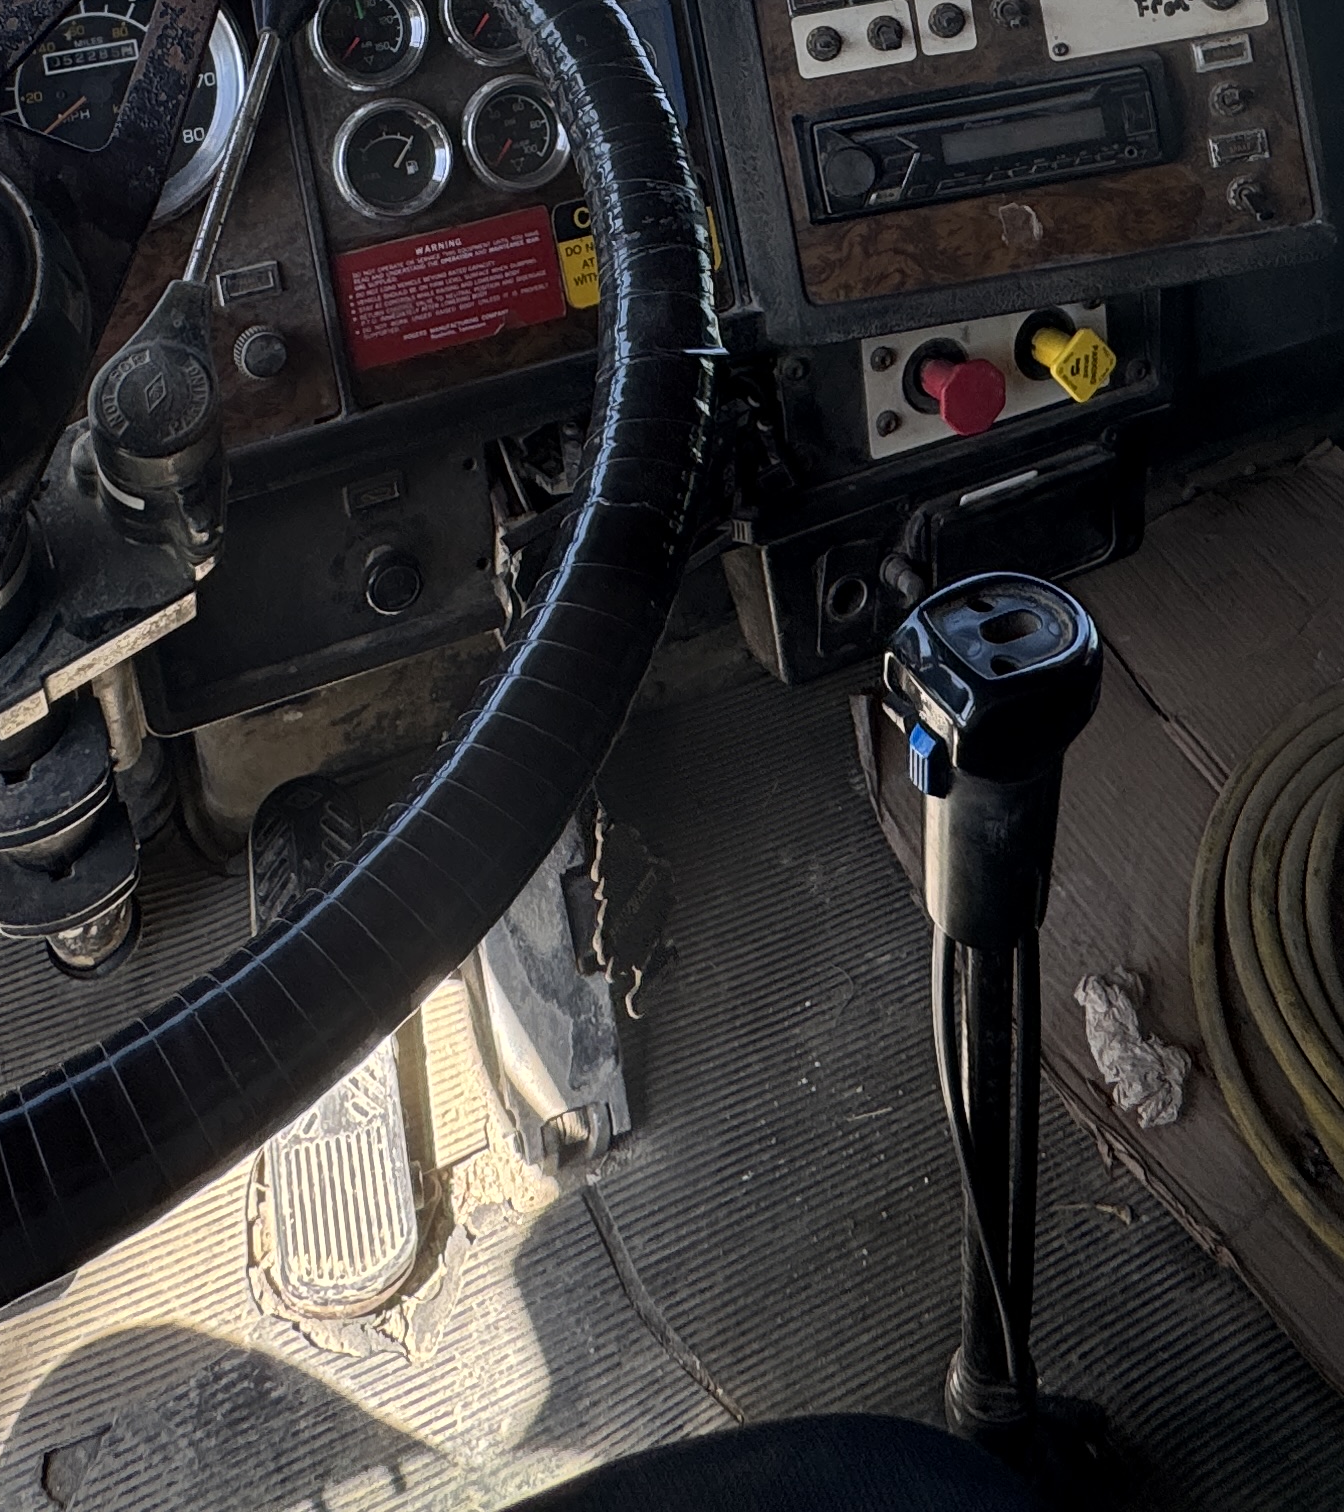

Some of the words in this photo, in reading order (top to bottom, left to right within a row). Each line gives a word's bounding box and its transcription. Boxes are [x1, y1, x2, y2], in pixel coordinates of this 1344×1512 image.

[112, 27, 128, 39] 80
[39, 42, 56, 54] 40
[74, 36, 104, 48] MILES
[25, 91, 43, 104] 20
[182, 127, 205, 144] 80
[415, 237, 463, 255] WARNING
[565, 245, 582, 257] DO
[104, 395, 126, 428] NOT
